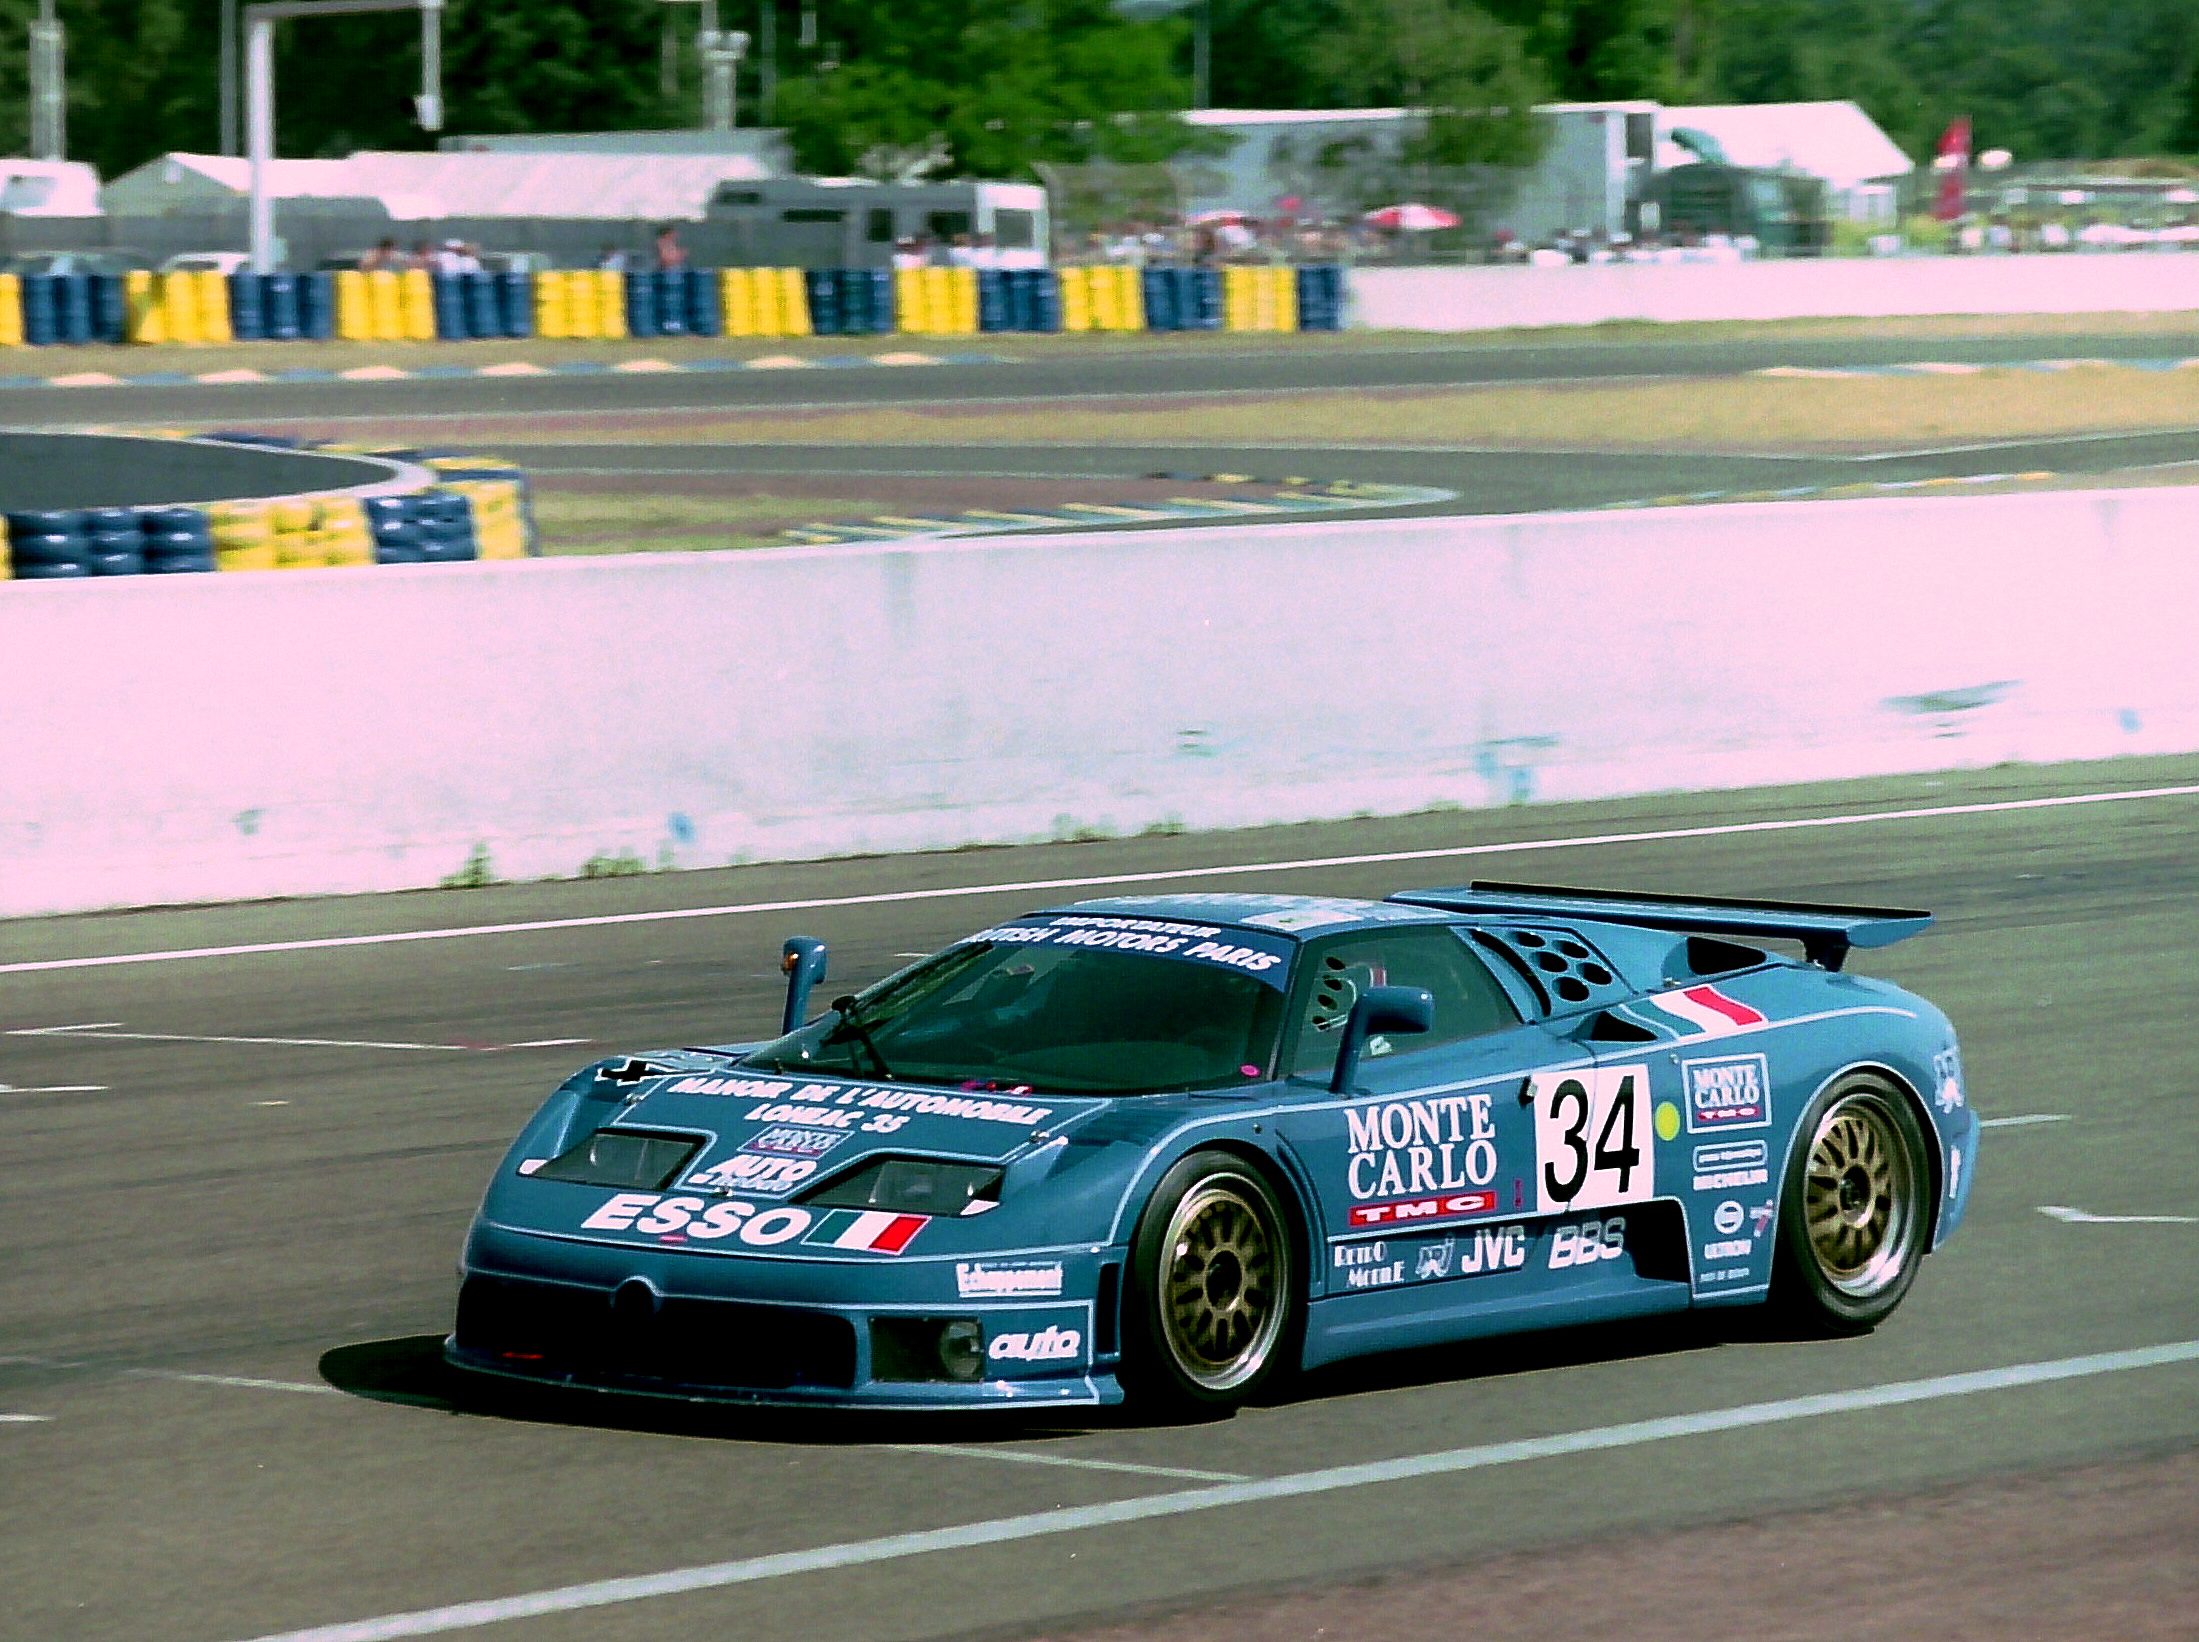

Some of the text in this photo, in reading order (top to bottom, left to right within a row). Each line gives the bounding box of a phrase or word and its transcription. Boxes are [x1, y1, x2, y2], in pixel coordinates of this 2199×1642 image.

[1053, 929, 1188, 953] MOTORS
[1183, 941, 1281, 970] PARIS
[1693, 1064, 1758, 1088] MONTE
[1694, 1085, 1760, 1109] CARLO
[861, 1114, 910, 1133] 35
[1344, 1094, 1495, 1153] MONTE
[1544, 1074, 1640, 1203] 34
[706, 1154, 817, 1182] AUTO
[1348, 1140, 1497, 1199] CARLO
[581, 1195, 812, 1245] ESSO
[1356, 1196, 1484, 1222] TMC
[1461, 1226, 1525, 1273] JVC
[1548, 1217, 1626, 1269] BBS
[988, 1325, 1081, 1361] auto
